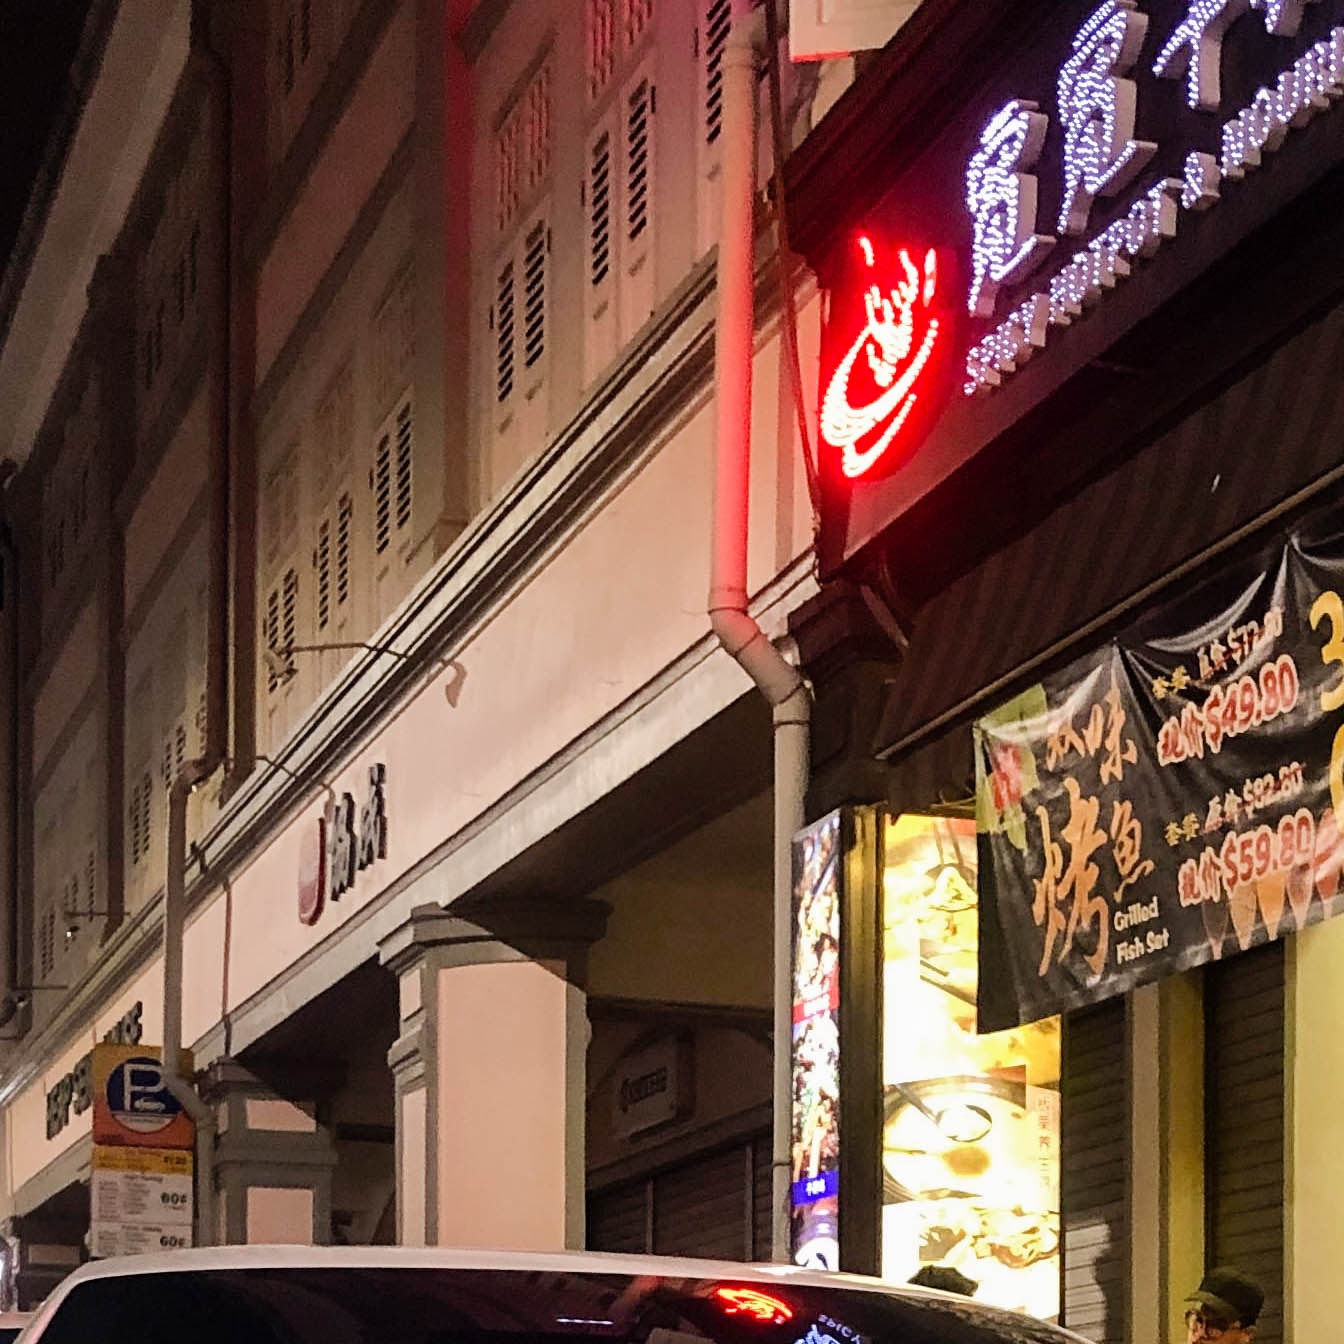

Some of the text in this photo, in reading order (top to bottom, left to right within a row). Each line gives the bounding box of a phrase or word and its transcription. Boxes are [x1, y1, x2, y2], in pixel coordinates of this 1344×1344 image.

[1048, 178, 1168, 324] HOTPOT
[1180, 152, 1205, 208] &
[1205, 653, 1299, 754] $49.80
[1221, 807, 1315, 899] $59.80
[1113, 896, 1159, 932] Grilled
[1116, 928, 1170, 964] Fish Set
